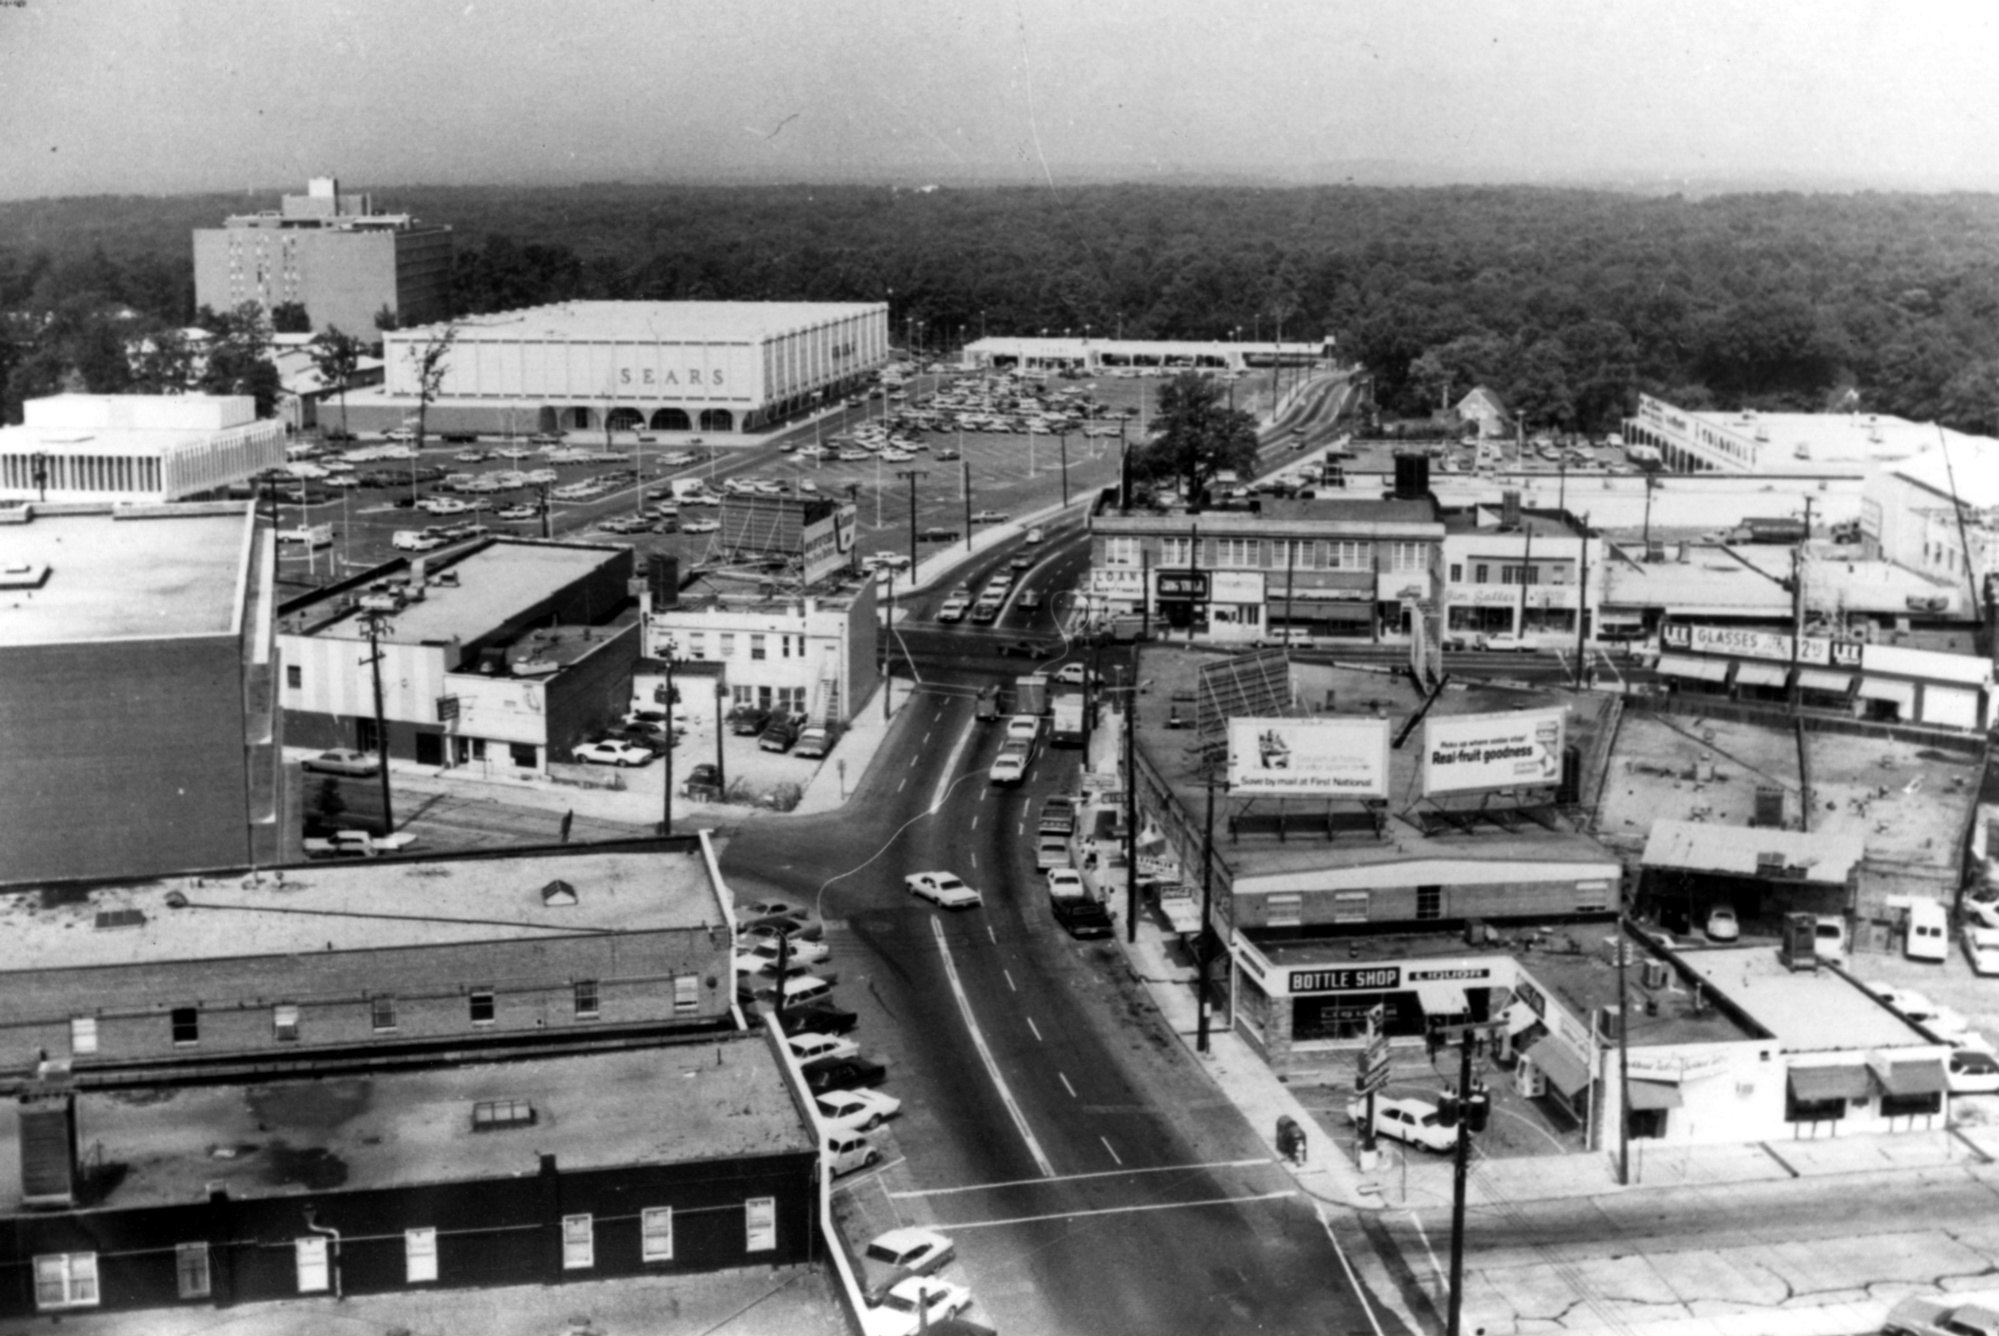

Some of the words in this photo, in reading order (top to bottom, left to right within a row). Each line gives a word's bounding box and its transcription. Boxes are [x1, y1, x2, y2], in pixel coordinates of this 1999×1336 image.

[620, 367, 724, 386] SEARS
[1095, 570, 1138, 583] LOAN
[1698, 629, 1758, 648] GLASSES
[1483, 745, 1534, 764] goodness
[1241, 775, 1264, 786] Save
[1264, 776, 1276, 788] by
[1277, 776, 1298, 786] mail
[1299, 777, 1309, 786] at
[1310, 776, 1331, 787] First
[1332, 777, 1373, 787] National
[1293, 971, 1350, 990] BOTTLE
[1356, 969, 1397, 987] SHOP
[1414, 968, 1483, 981] LIQUOR
